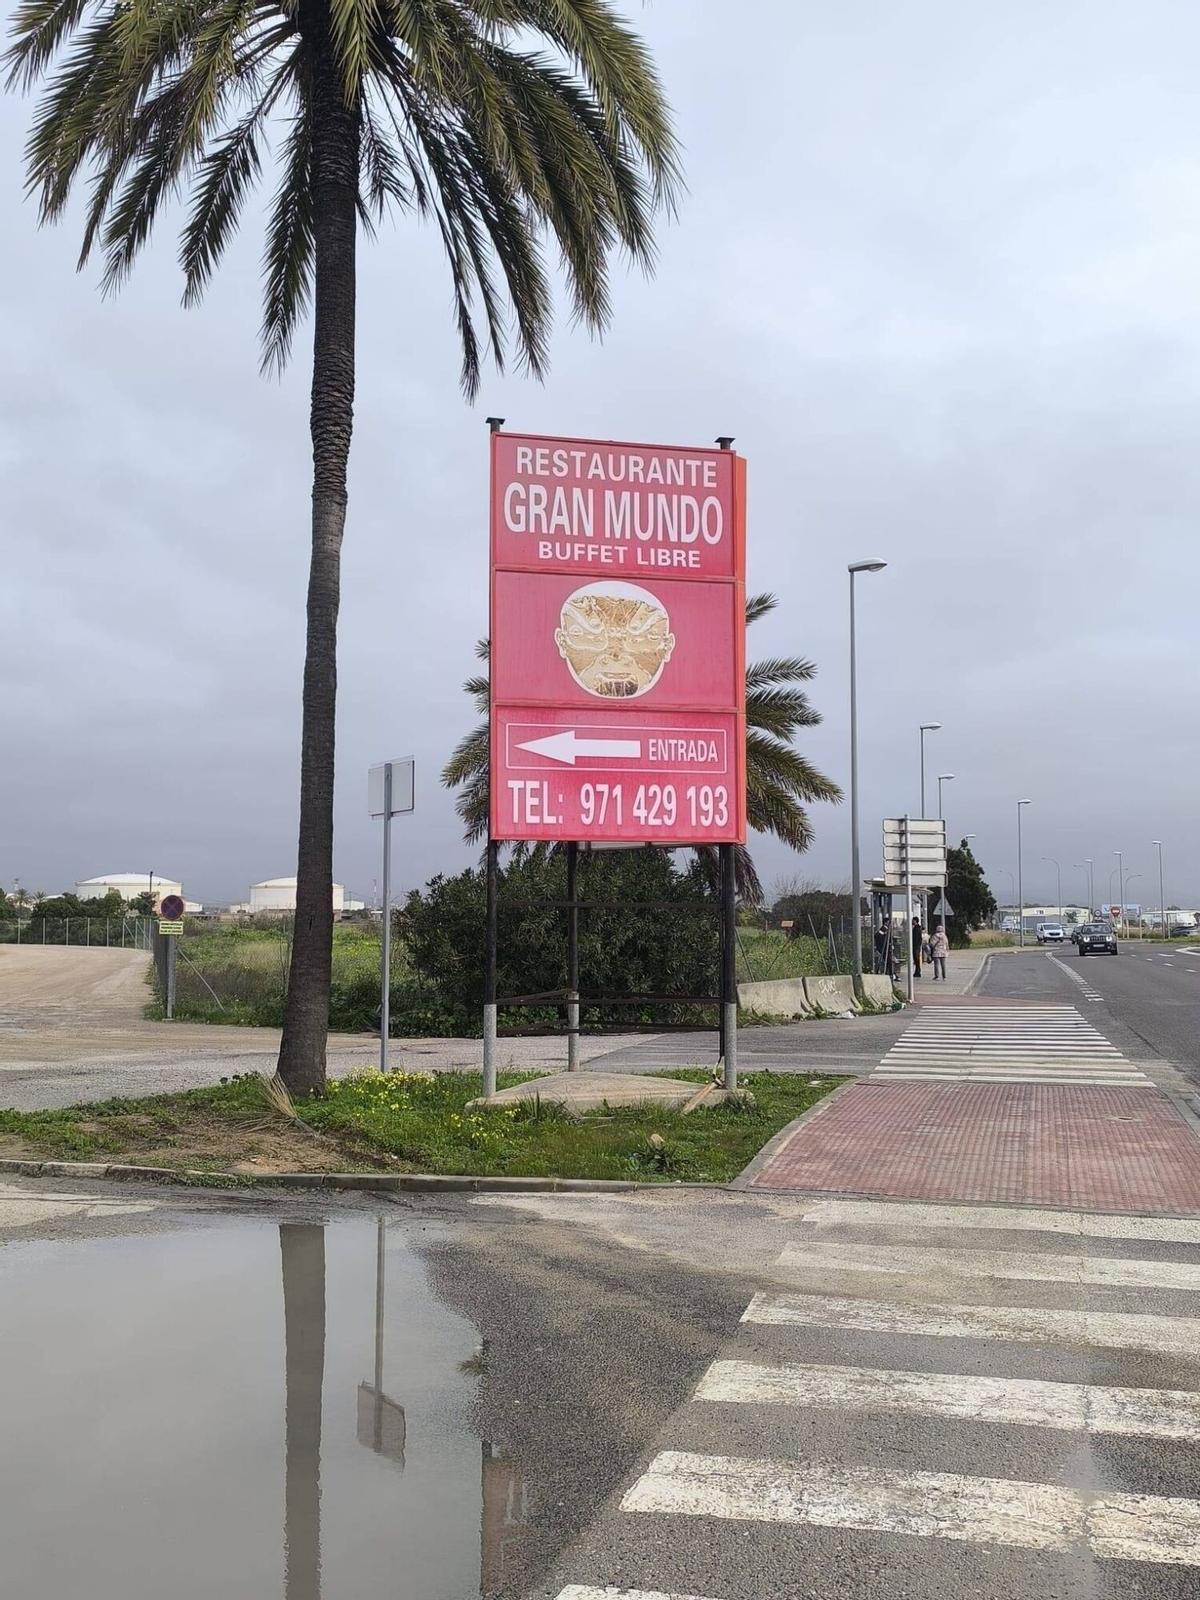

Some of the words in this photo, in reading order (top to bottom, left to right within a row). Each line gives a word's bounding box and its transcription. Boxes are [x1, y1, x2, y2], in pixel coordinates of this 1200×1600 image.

[516, 446, 718, 488] RESTAURANTE
[503, 481, 594, 537] GRAN
[604, 489, 723, 545] MUNDO
[538, 541, 628, 564] BUFFET
[636, 547, 701, 568] LIBRE
[648, 738, 719, 762] ENTRADA
[507, 780, 564, 825] TEL:
[580, 783, 623, 825] 971
[632, 784, 677, 826] 429
[686, 785, 729, 827] 193
